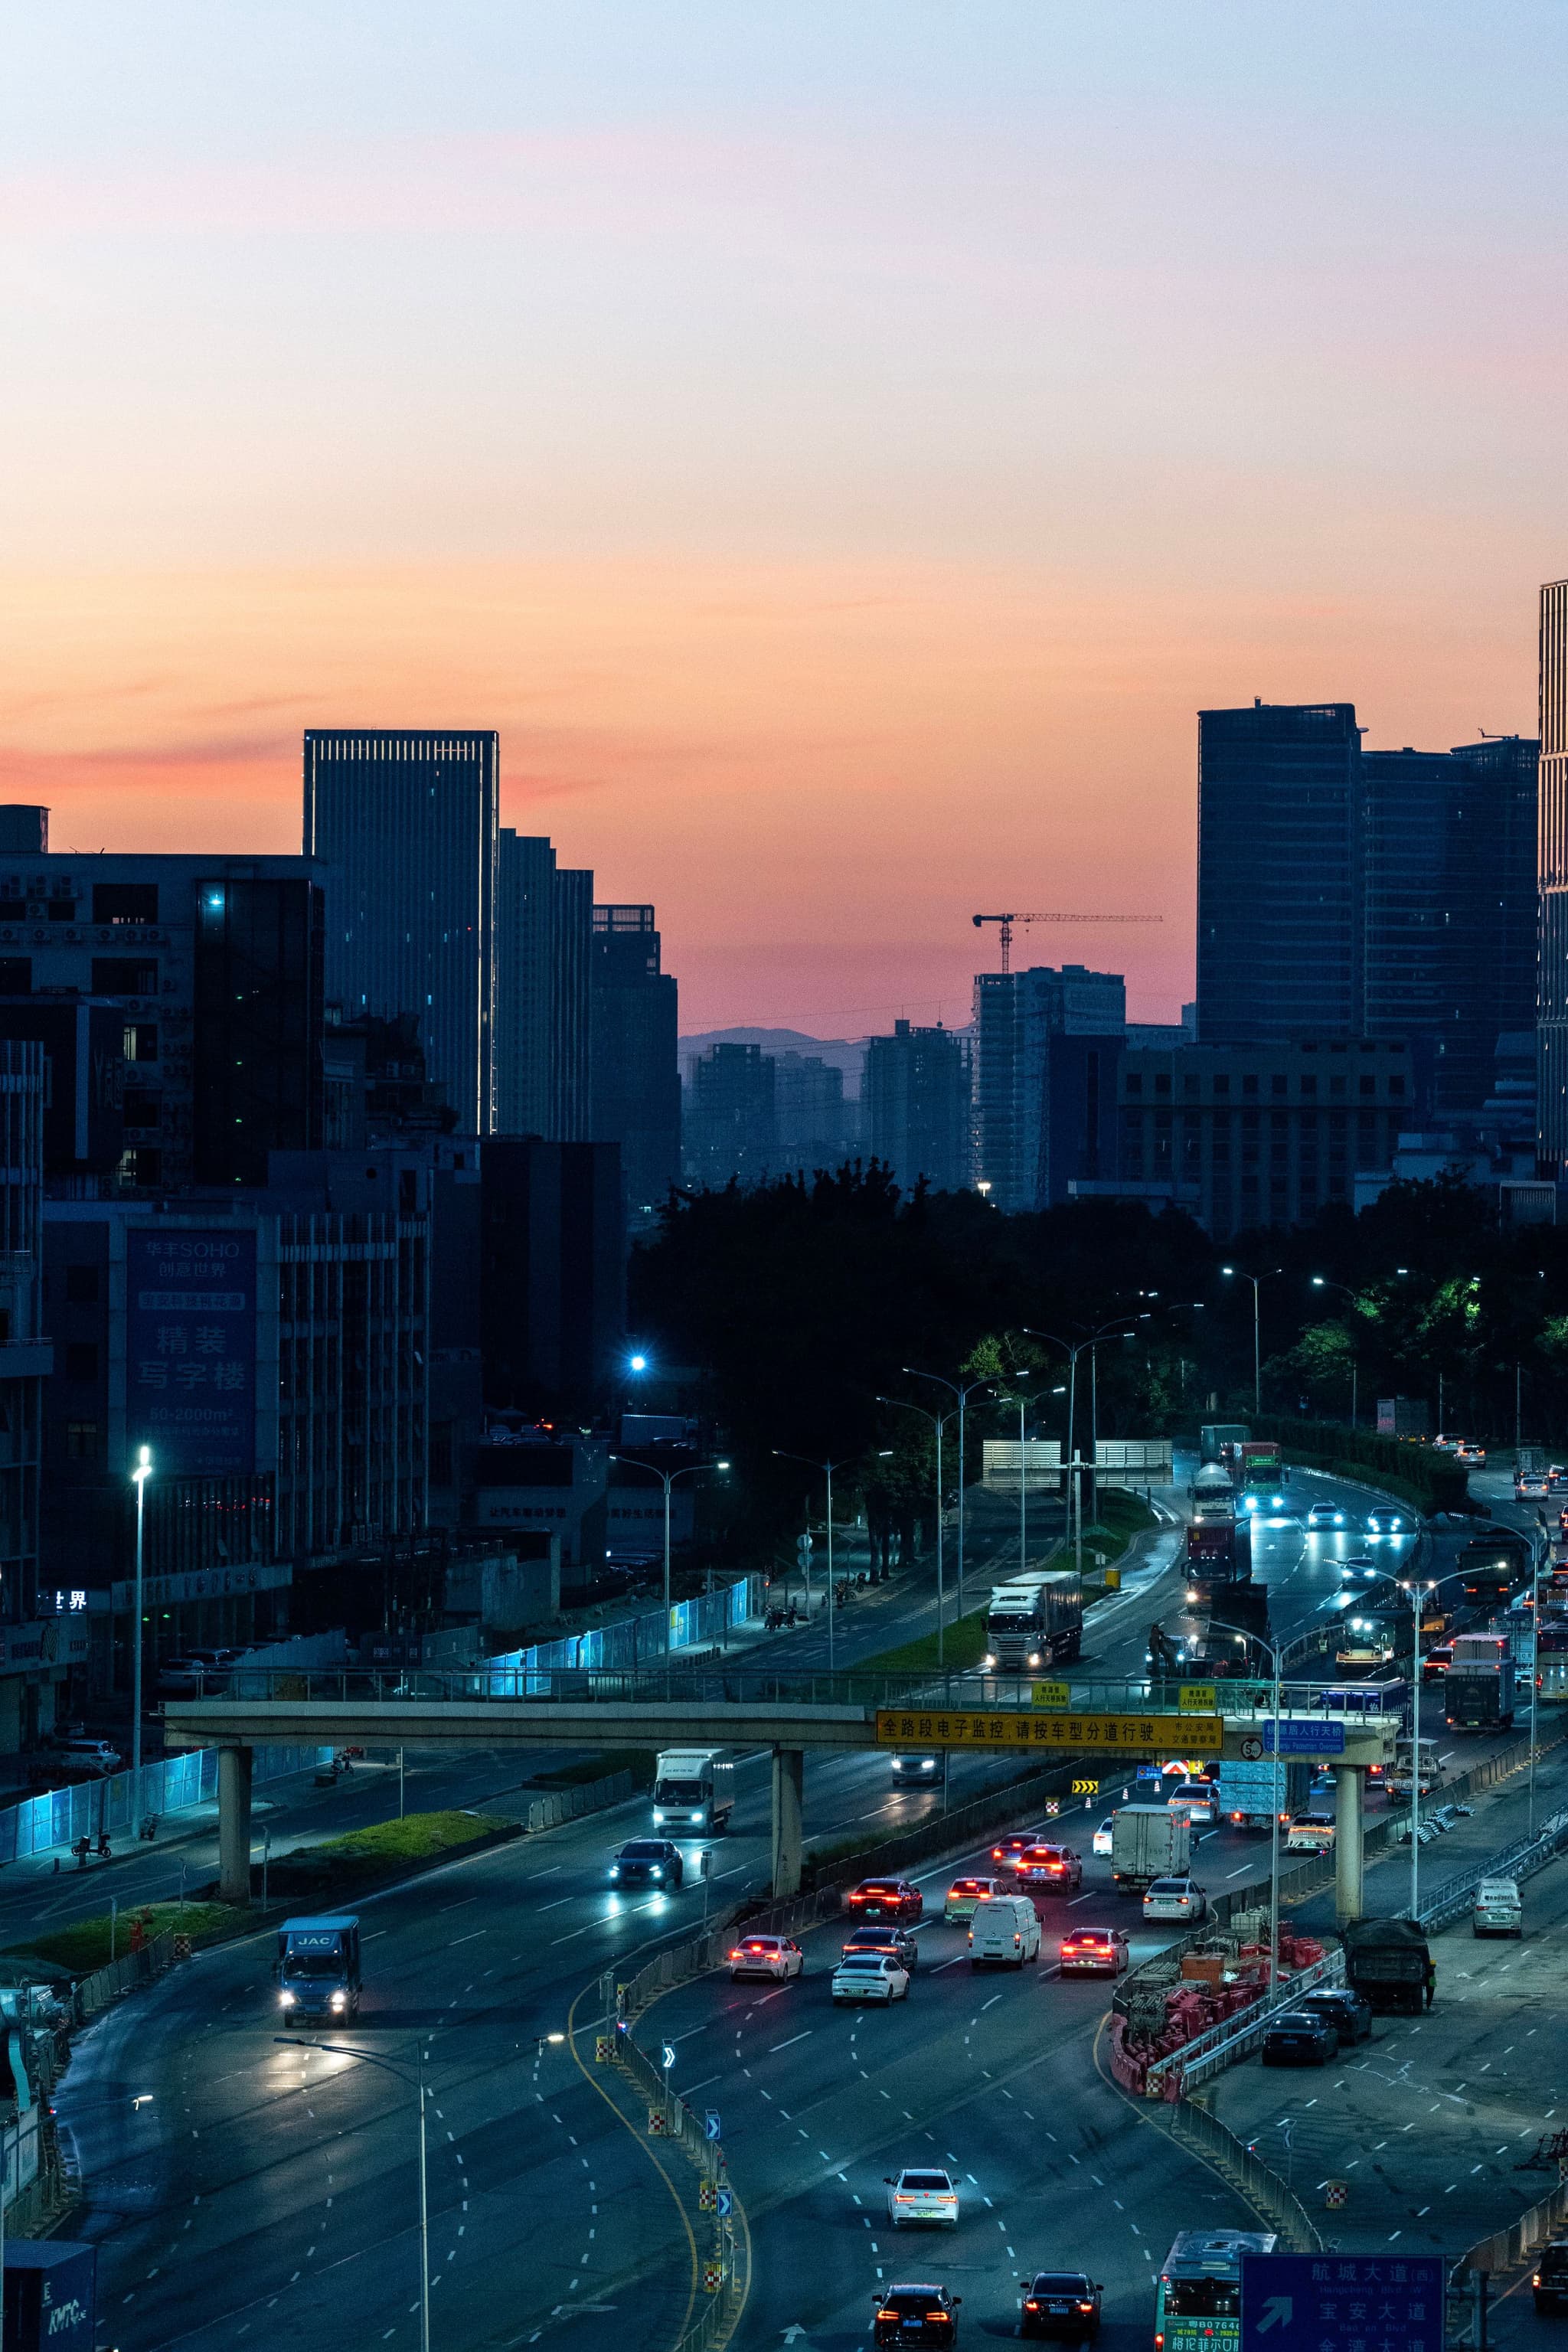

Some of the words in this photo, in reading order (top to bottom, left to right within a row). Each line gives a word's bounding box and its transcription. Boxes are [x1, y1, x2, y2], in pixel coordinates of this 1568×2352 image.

[147, 1241, 240, 1258] 华丰SOHO
[158, 1262, 227, 1278] 创意世界
[158, 1325, 227, 1354] 精装
[138, 1361, 245, 1390] 写字楼
[1319, 2301, 1426, 2321] 宝安大道
